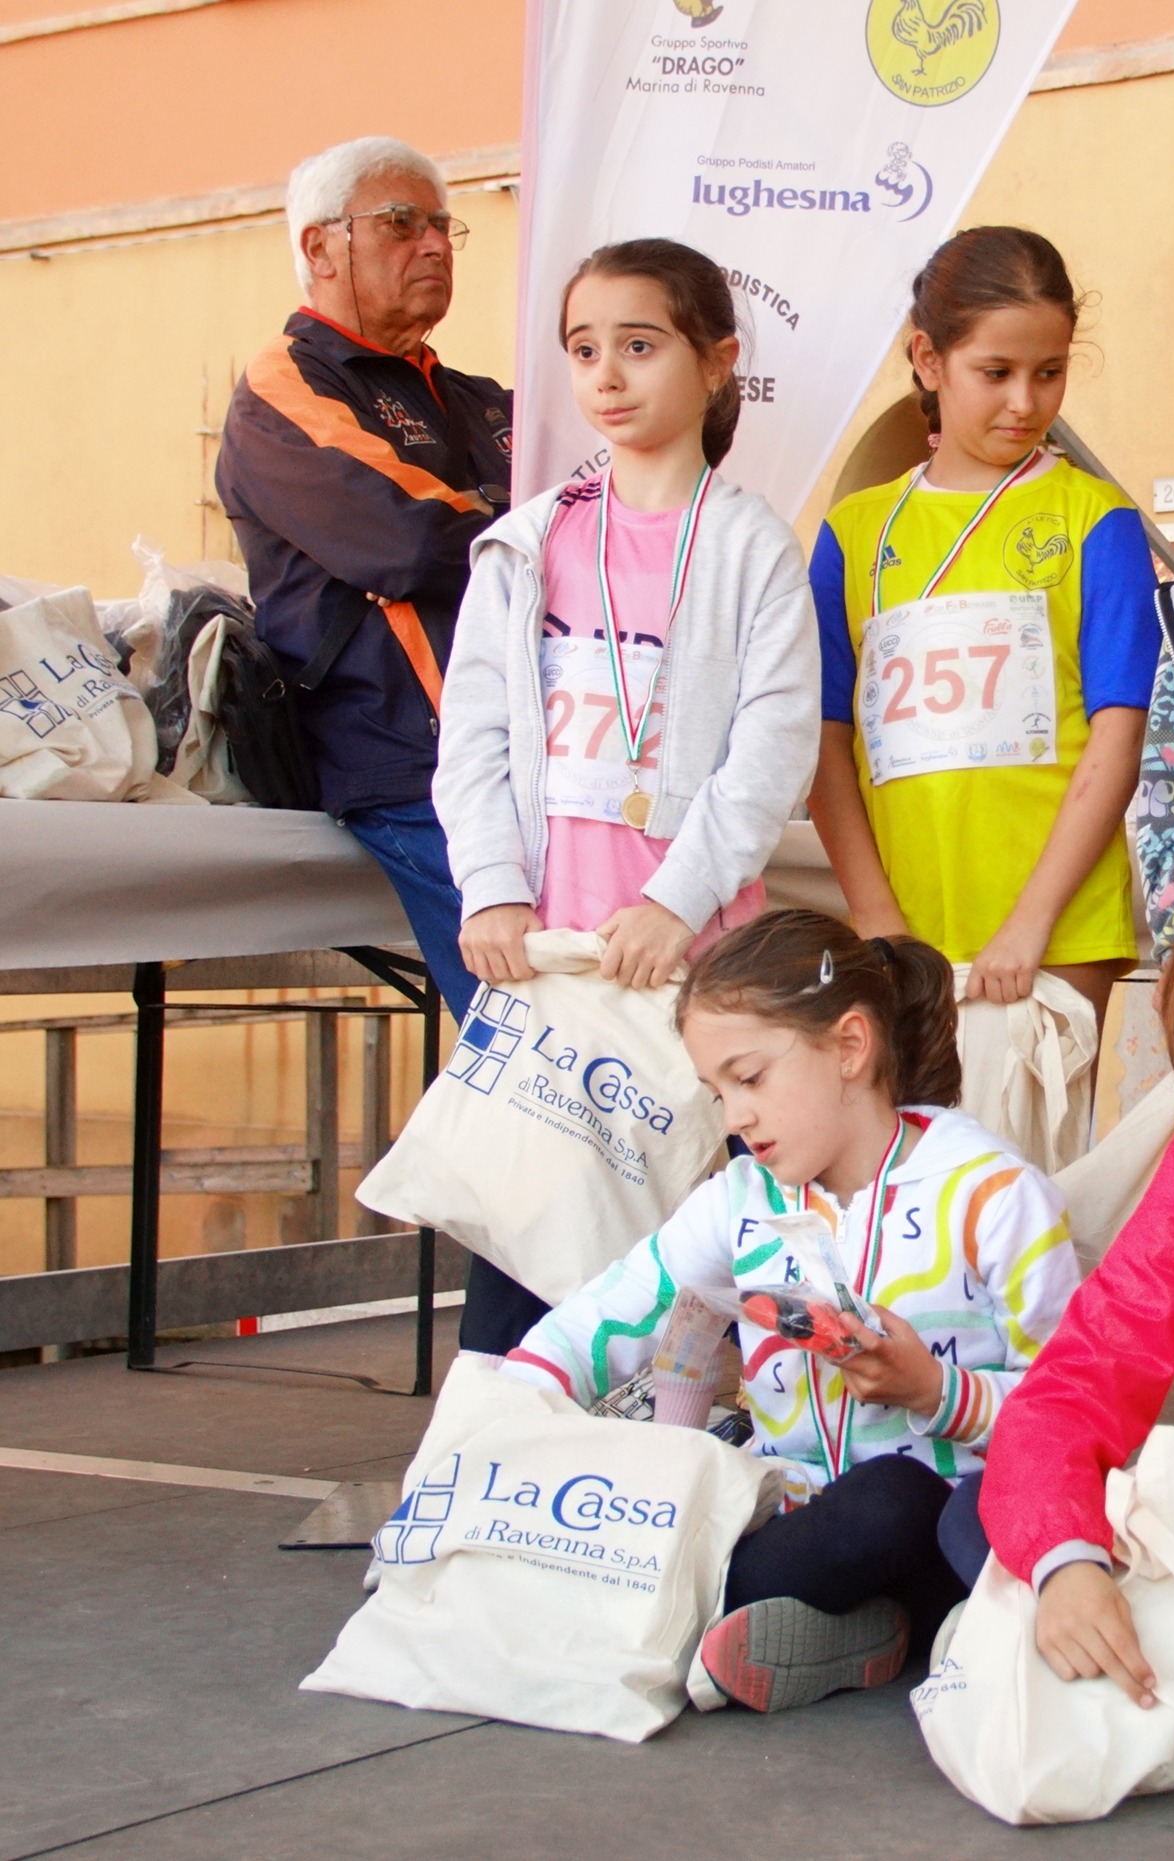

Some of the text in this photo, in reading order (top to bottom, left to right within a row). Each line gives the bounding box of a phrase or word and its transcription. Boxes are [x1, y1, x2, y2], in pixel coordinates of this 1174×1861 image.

[651, 35, 748, 53] Gruppo Sportivo
[626, 77, 765, 97] Marina di Ravenna
[891, 73, 966, 98] SAN PATRIZIO
[697, 155, 816, 171] Gruppo Podisti Amatori
[692, 175, 872, 217] lughesina
[880, 637, 899, 650] LUCCI
[880, 644, 1011, 725] 257
[546, 690, 664, 769] 272
[532, 1025, 675, 1135] La Cassa
[518, 1077, 531, 1094] di
[532, 1074, 613, 1145] Ravenna
[508, 1097, 645, 1186] Privata e Indipendente dal 1840
[737, 1218, 758, 1247] F
[902, 1207, 922, 1240] S
[931, 1337, 957, 1365] M
[773, 1362, 785, 1393] S
[480, 1462, 677, 1531] La Cassa
[465, 1527, 480, 1541] di
[485, 1519, 606, 1560] Ravenna
[611, 1548, 662, 1572] S.p.A.
[519, 1554, 597, 1580] Indipendente
[602, 1574, 620, 1586] dal
[627, 1579, 656, 1593] 1840
